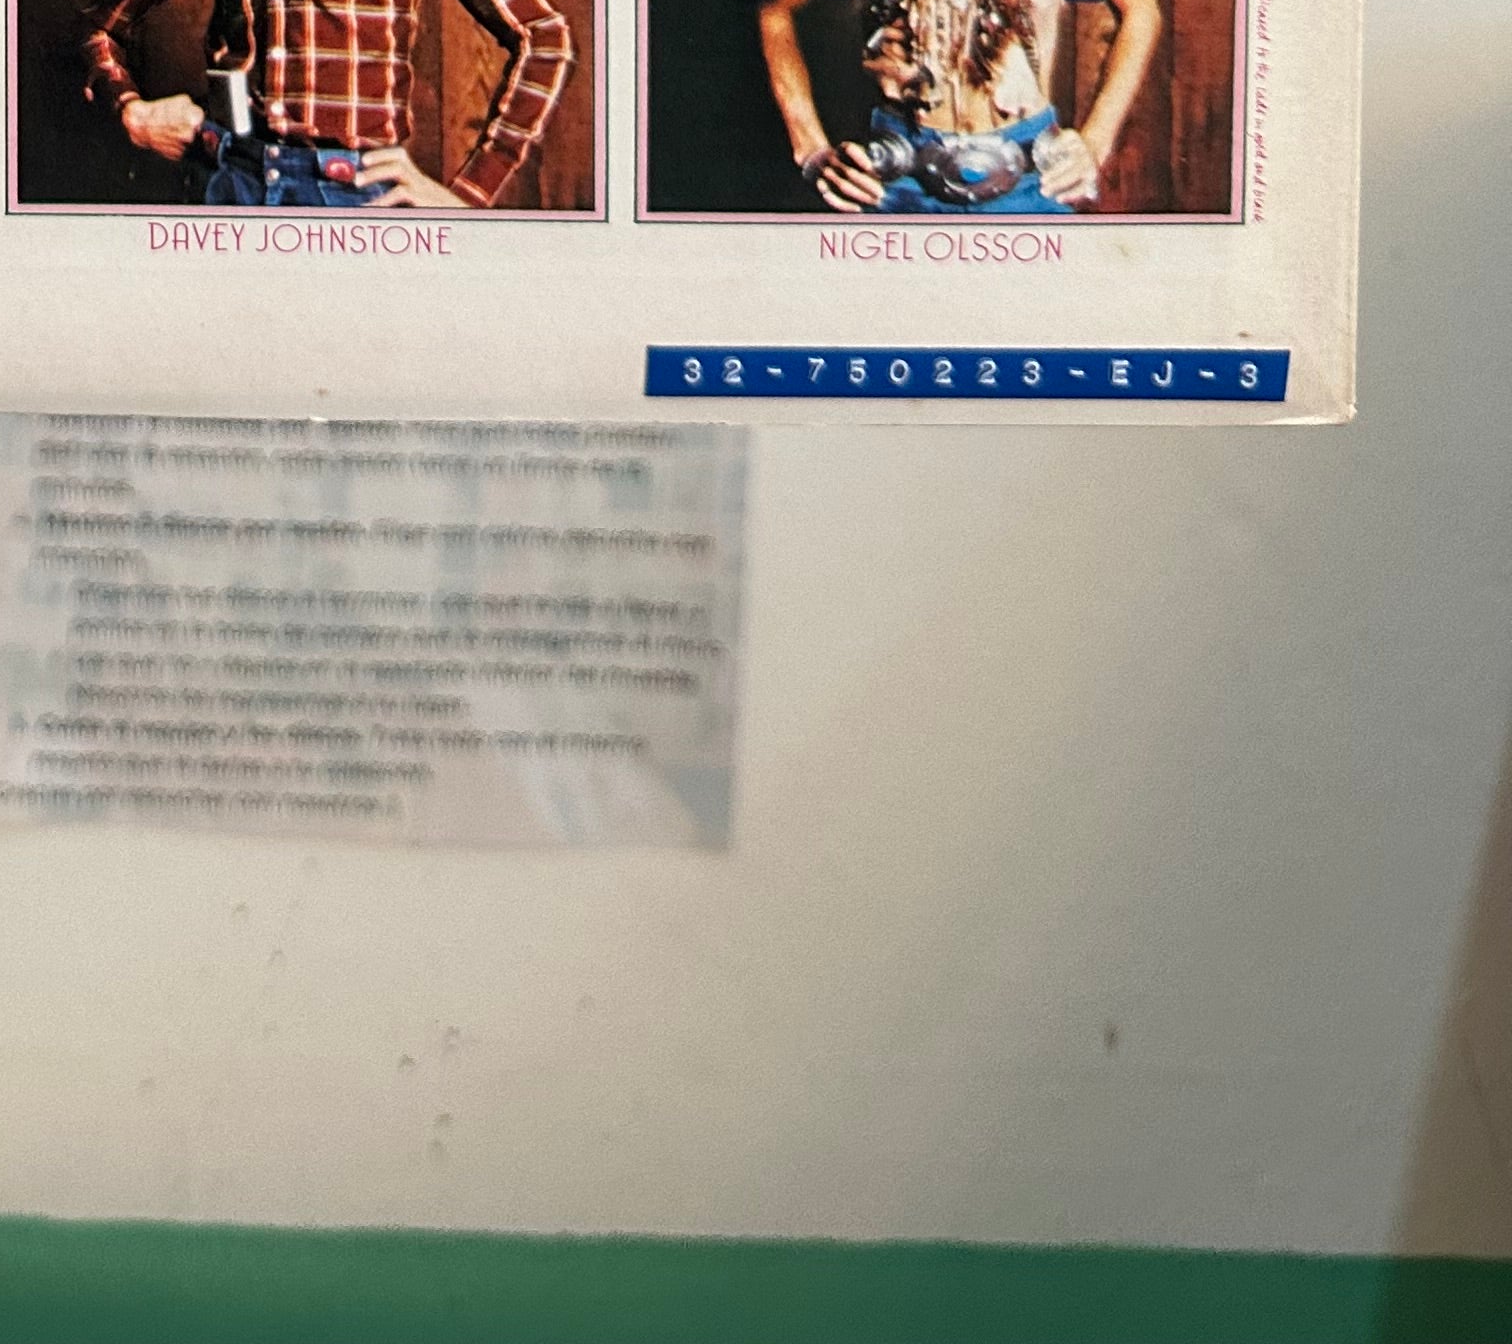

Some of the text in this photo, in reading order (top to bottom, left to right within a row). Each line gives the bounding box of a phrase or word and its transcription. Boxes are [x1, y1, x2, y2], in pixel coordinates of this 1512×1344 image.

[148, 222, 452, 255] DAVEY JOHNSTONE
[820, 231, 1062, 262] NIGEL OLSSON
[683, 358, 1259, 388] 32-750223-EJ-3
